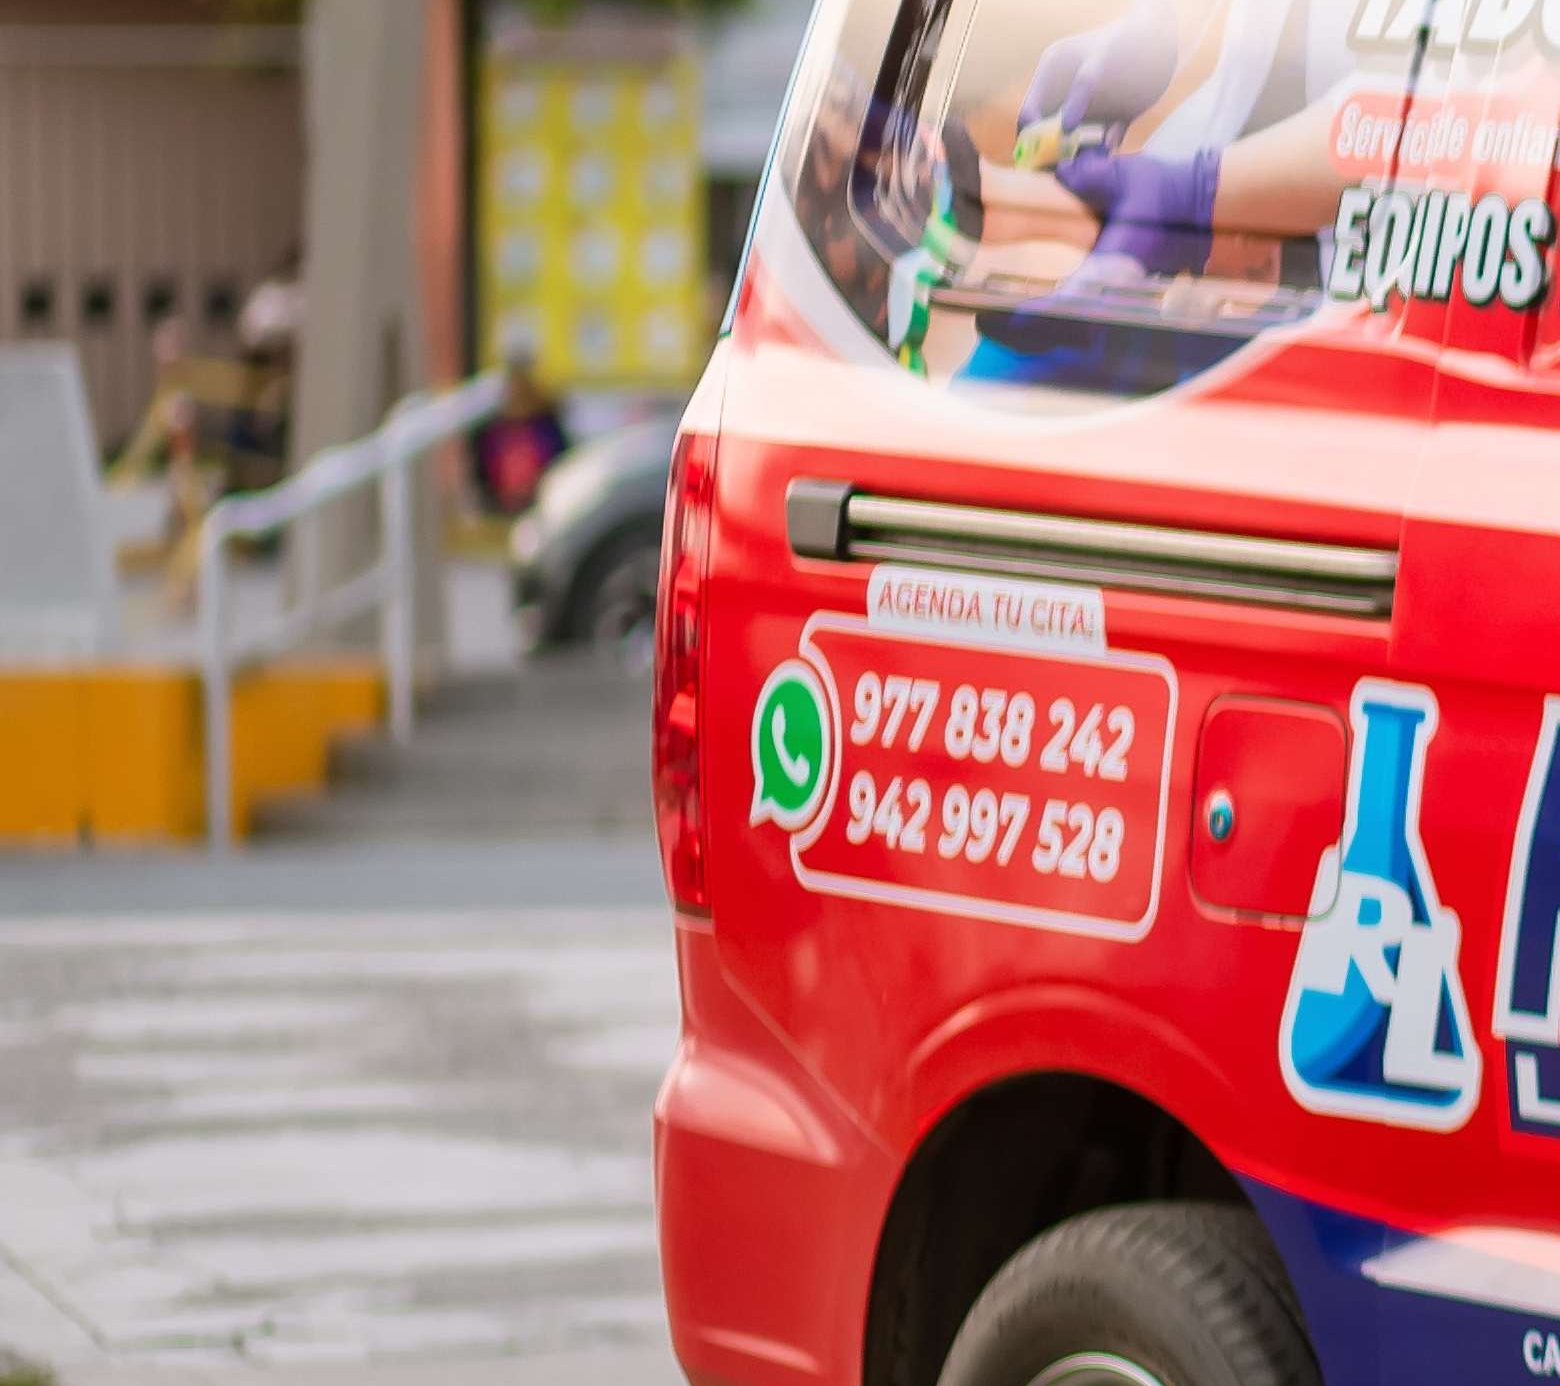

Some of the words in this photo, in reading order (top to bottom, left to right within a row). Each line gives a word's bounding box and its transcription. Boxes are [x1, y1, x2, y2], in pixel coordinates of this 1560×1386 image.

[1329, 184, 1554, 313] EQUIPOS
[877, 578, 983, 629] AGENDA
[993, 590, 1025, 632] TU
[850, 670, 941, 752] 977
[943, 683, 1036, 768] 838
[1039, 697, 1136, 782] 242
[845, 769, 932, 854] 942
[937, 782, 1030, 867] 997
[1031, 799, 1126, 884] 528
